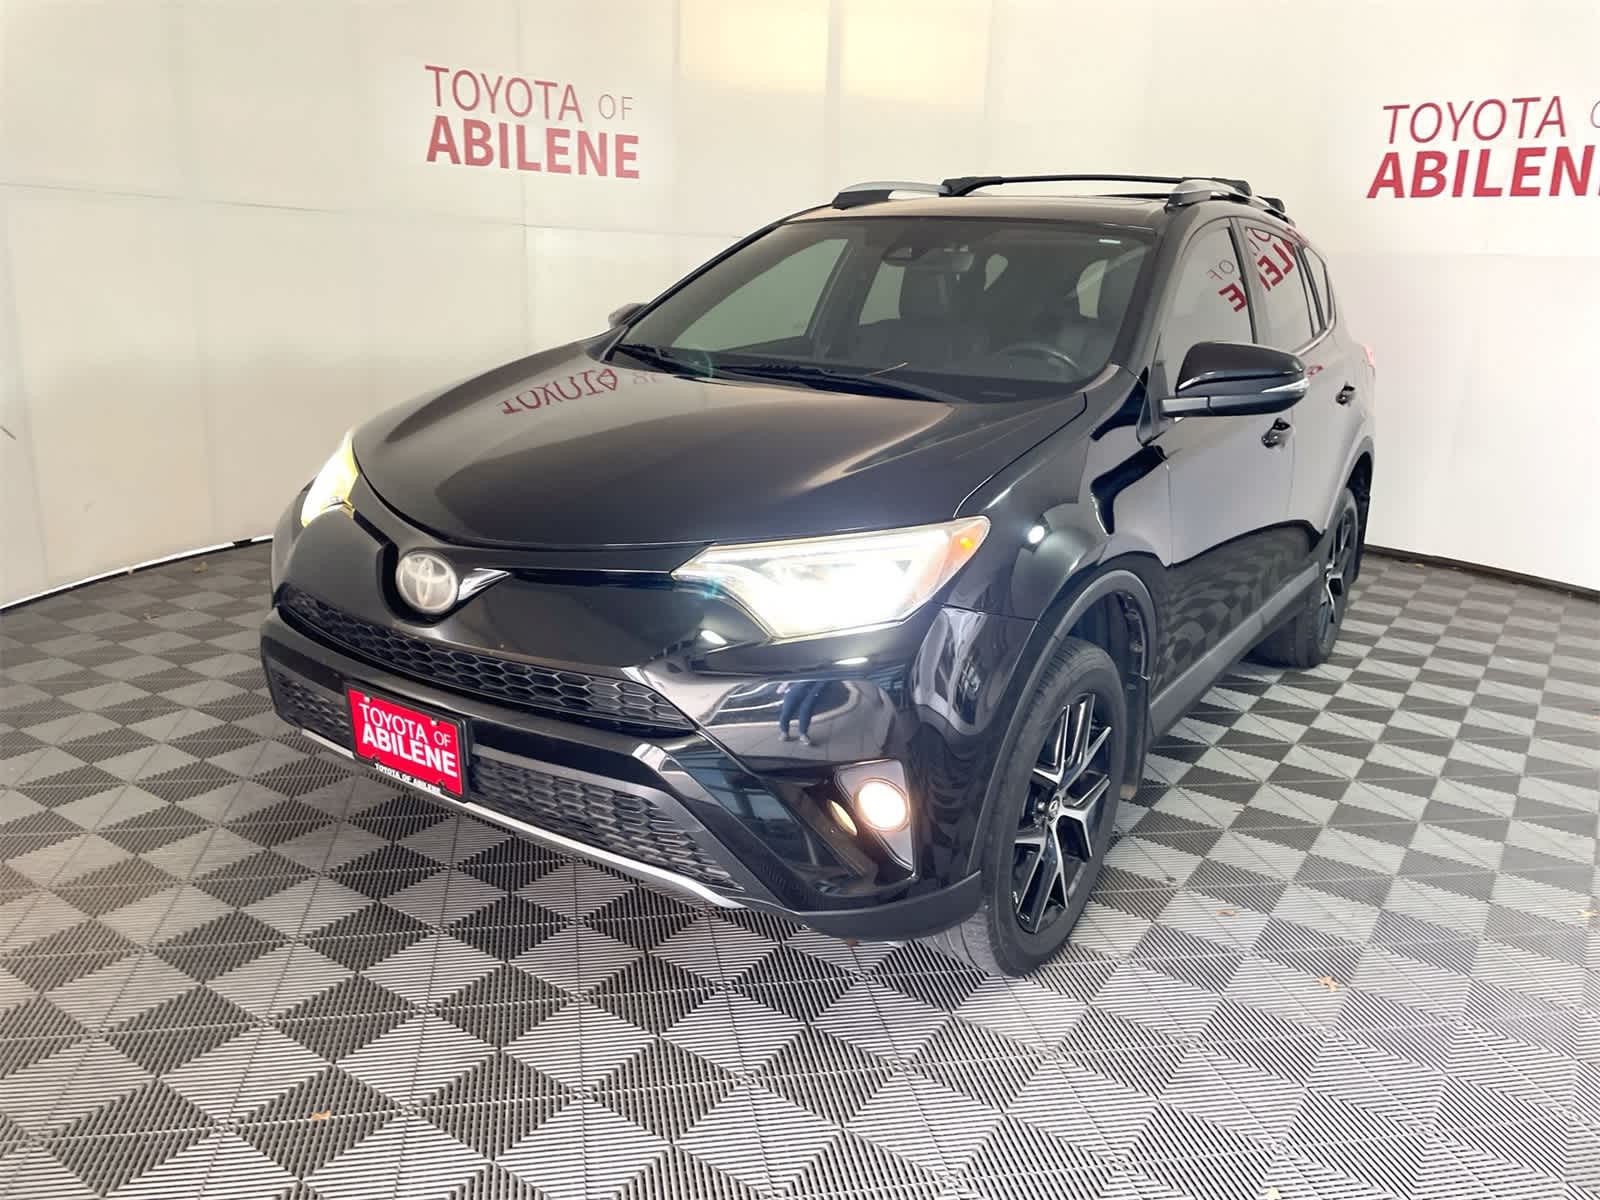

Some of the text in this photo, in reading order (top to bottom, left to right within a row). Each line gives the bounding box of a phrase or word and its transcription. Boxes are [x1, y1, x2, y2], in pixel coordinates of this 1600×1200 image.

[425, 64, 633, 123] TOYOTA OF
[1383, 96, 1566, 144] TOYOTA
[426, 115, 640, 179] ABILENE
[1366, 145, 1600, 198] ABILEN
[358, 703, 452, 747] TOYOTA OF
[362, 723, 458, 778] ABILENE
